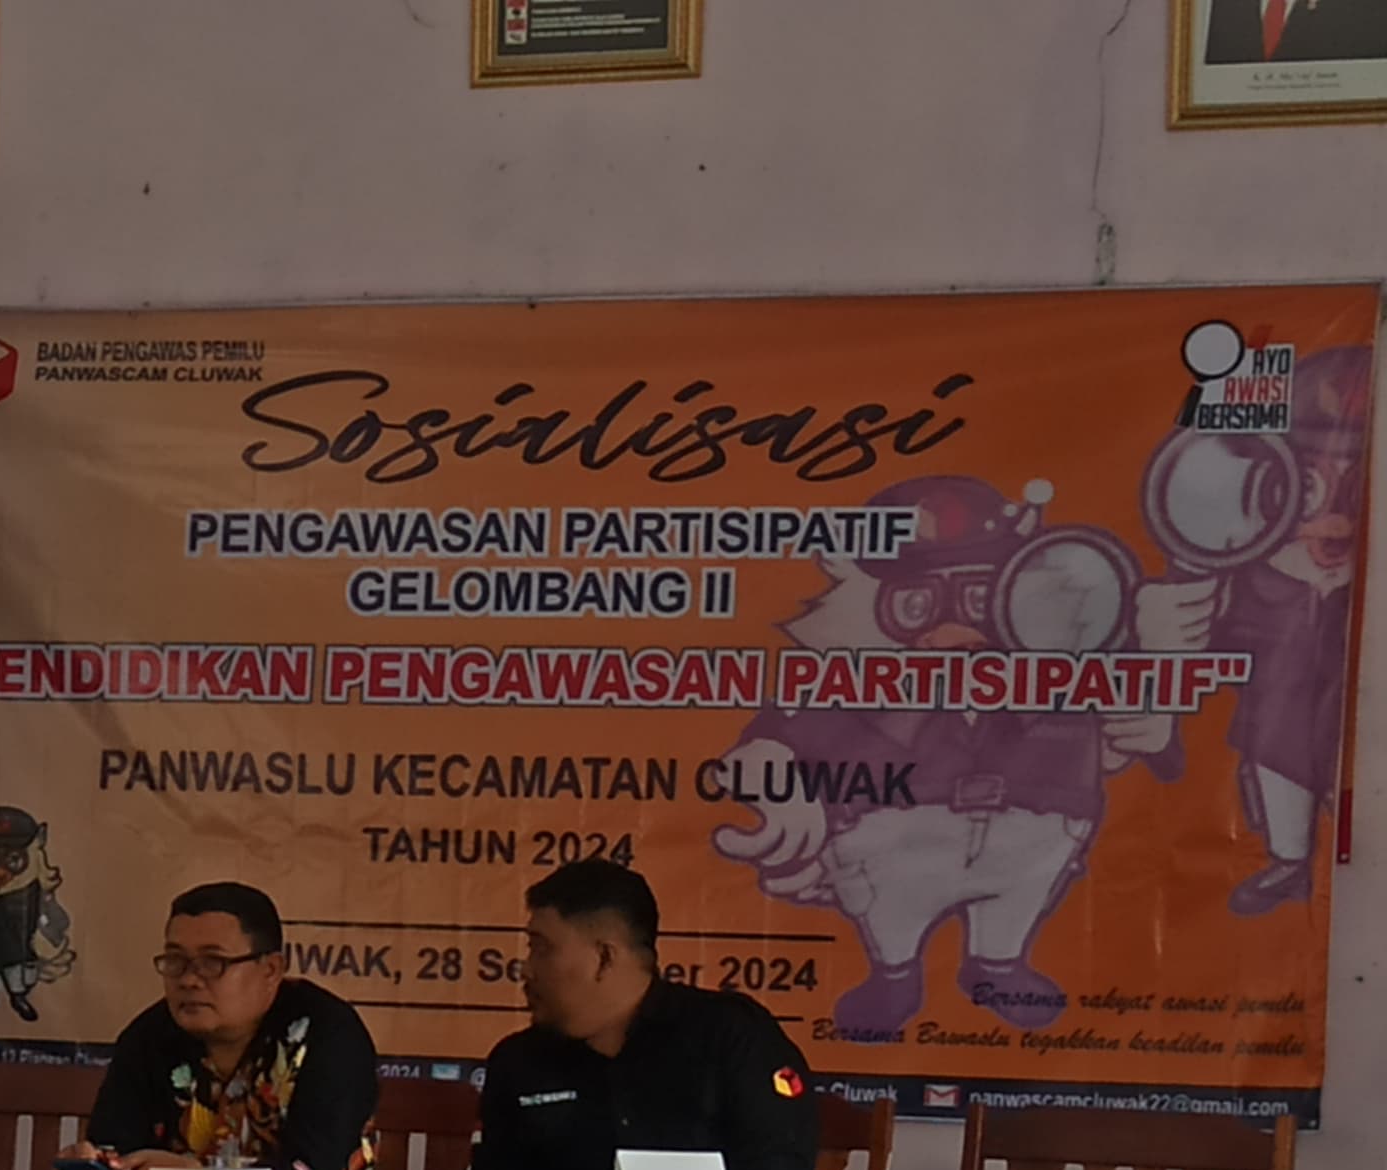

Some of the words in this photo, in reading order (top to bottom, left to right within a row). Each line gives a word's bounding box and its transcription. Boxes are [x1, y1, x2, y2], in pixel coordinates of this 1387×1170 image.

[37, 342, 97, 363] BADAN
[102, 341, 197, 362] PENGAWAS
[200, 340, 265, 362] PEMILU
[1252, 348, 1291, 374] AYO
[35, 365, 168, 384] PANWASCAM
[172, 365, 263, 383] CLUWAK
[1224, 375, 1288, 402] AWASI
[241, 369, 975, 484] Sosialisasi
[1197, 403, 1288, 430] BERSAMA
[187, 510, 546, 557] PENGAWASAN
[562, 507, 915, 558] PARTISIPATIF
[350, 570, 688, 616] GELOMBANG
[699, 570, 733, 617] II
[325, 648, 767, 706] PENGAWASAN
[780, 650, 1253, 711] PARTISIPATIF"
[99, 749, 356, 796] PANWASLU
[372, 753, 677, 802] KECAMATAN
[694, 758, 918, 806] CLUWAK
[363, 826, 515, 865] TAHUN
[532, 830, 634, 867] 2024
[417, 946, 462, 981] 28
[719, 956, 818, 991] 2024
[971, 982, 1068, 1008] Bersama
[1079, 988, 1155, 1014] rakyat
[1162, 992, 1228, 1013] awasi
[1234, 995, 1306, 1016] pemilu
[812, 1017, 905, 1044] Bersama
[915, 1021, 1011, 1047] Bawaslu
[1020, 1028, 1121, 1056] tegakkan
[1128, 1032, 1225, 1055] keadilan
[1233, 1036, 1307, 1058] pemilu
